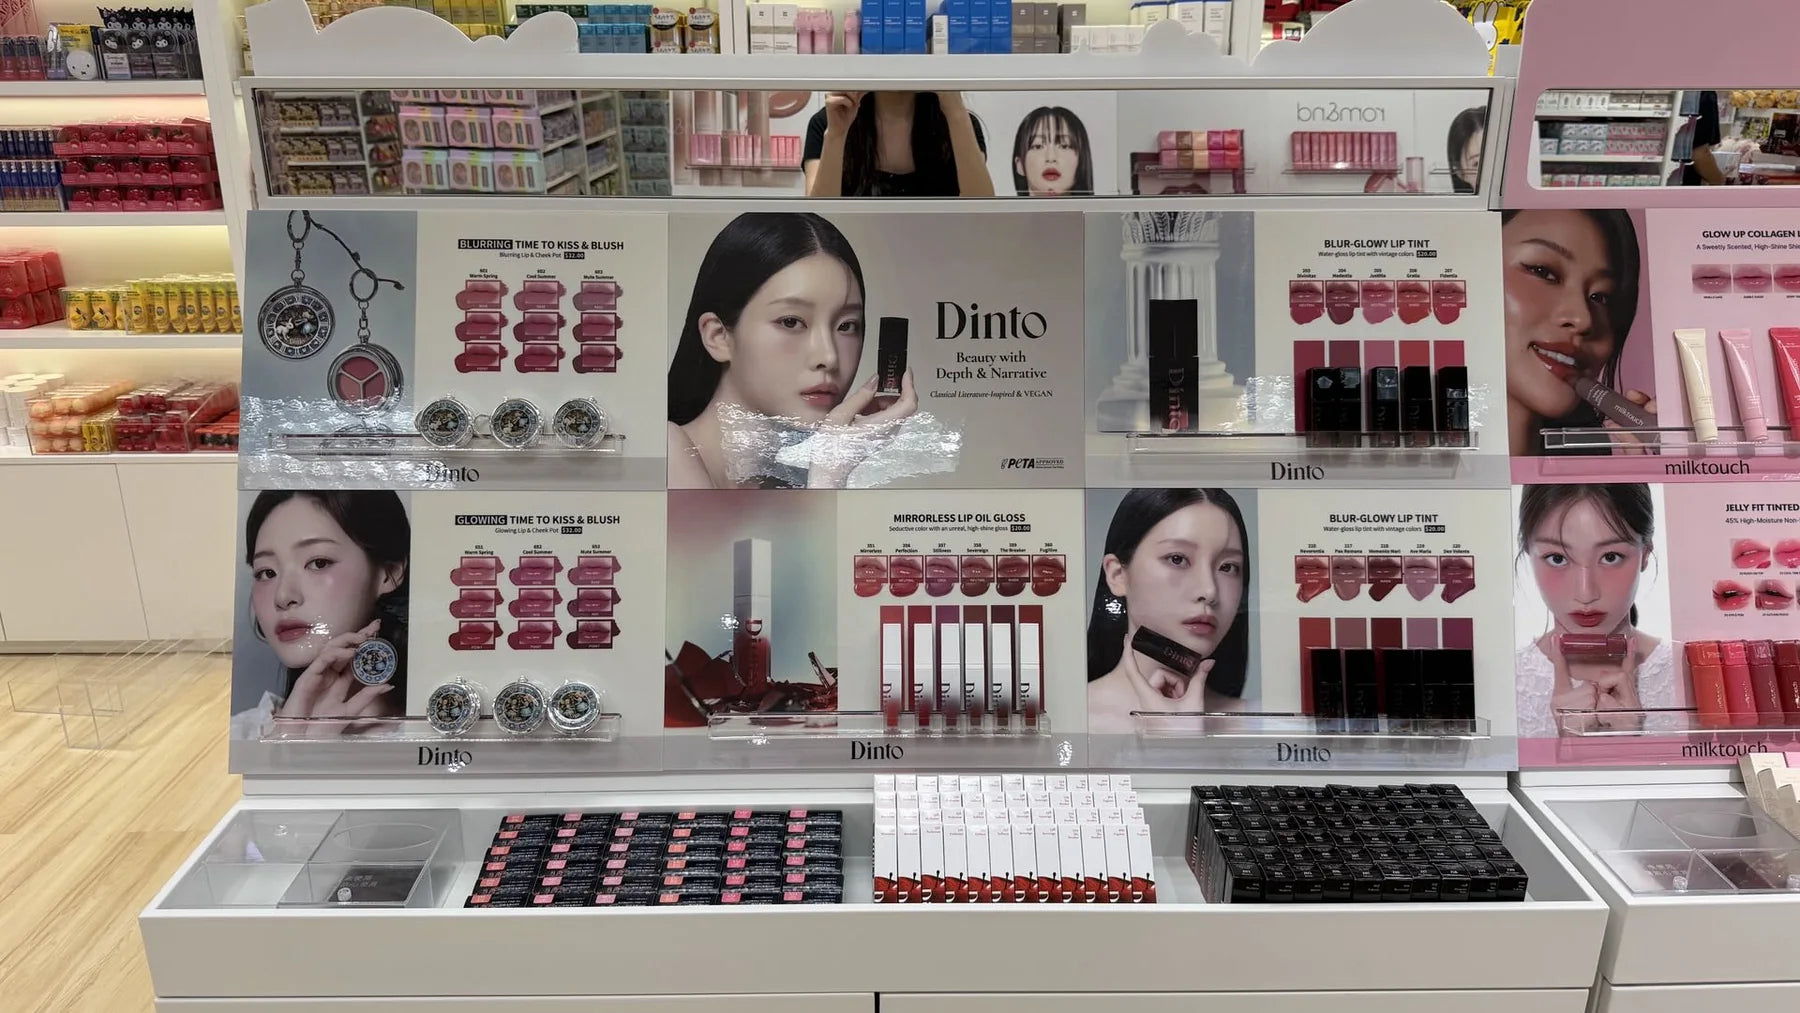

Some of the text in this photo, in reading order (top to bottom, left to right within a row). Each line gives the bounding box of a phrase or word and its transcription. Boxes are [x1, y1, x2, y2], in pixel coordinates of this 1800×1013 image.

[1702, 231, 1795, 239] GLOW UP COLLAGEN
[460, 240, 624, 250] BLURRING TIME TO KISS & BLUSH
[1324, 240, 1430, 248] BLUR-GLOWY LIP TINT
[499, 252, 521, 260] Blurring
[936, 301, 1047, 340] Dinto
[956, 350, 1026, 366] Beauty with
[936, 367, 1047, 383] Depth & Narrative
[930, 390, 1053, 400] Classical Literature-Inspired & VEGAN
[1168, 368, 1185, 432] Dinto
[1614, 404, 1644, 426] milktouch
[1271, 461, 1325, 481] Dinto
[1665, 460, 1750, 475] milktouch
[1726, 504, 1800, 513] JELLY FIT TINTED
[457, 515, 620, 524] GLOWING TIME TO KISS & BLUSH
[893, 514, 1026, 523] MIRRORLESS LIP OIL GLOSS
[1329, 514, 1438, 523] BLUR-GLOWY LIP TINT
[495, 527, 517, 535] Glowing
[967, 525, 994, 533] high-shine
[851, 741, 904, 760] Dinto
[1277, 742, 1331, 762] Dinto
[1682, 741, 1768, 757] milktouch
[418, 746, 472, 766] Dinto
